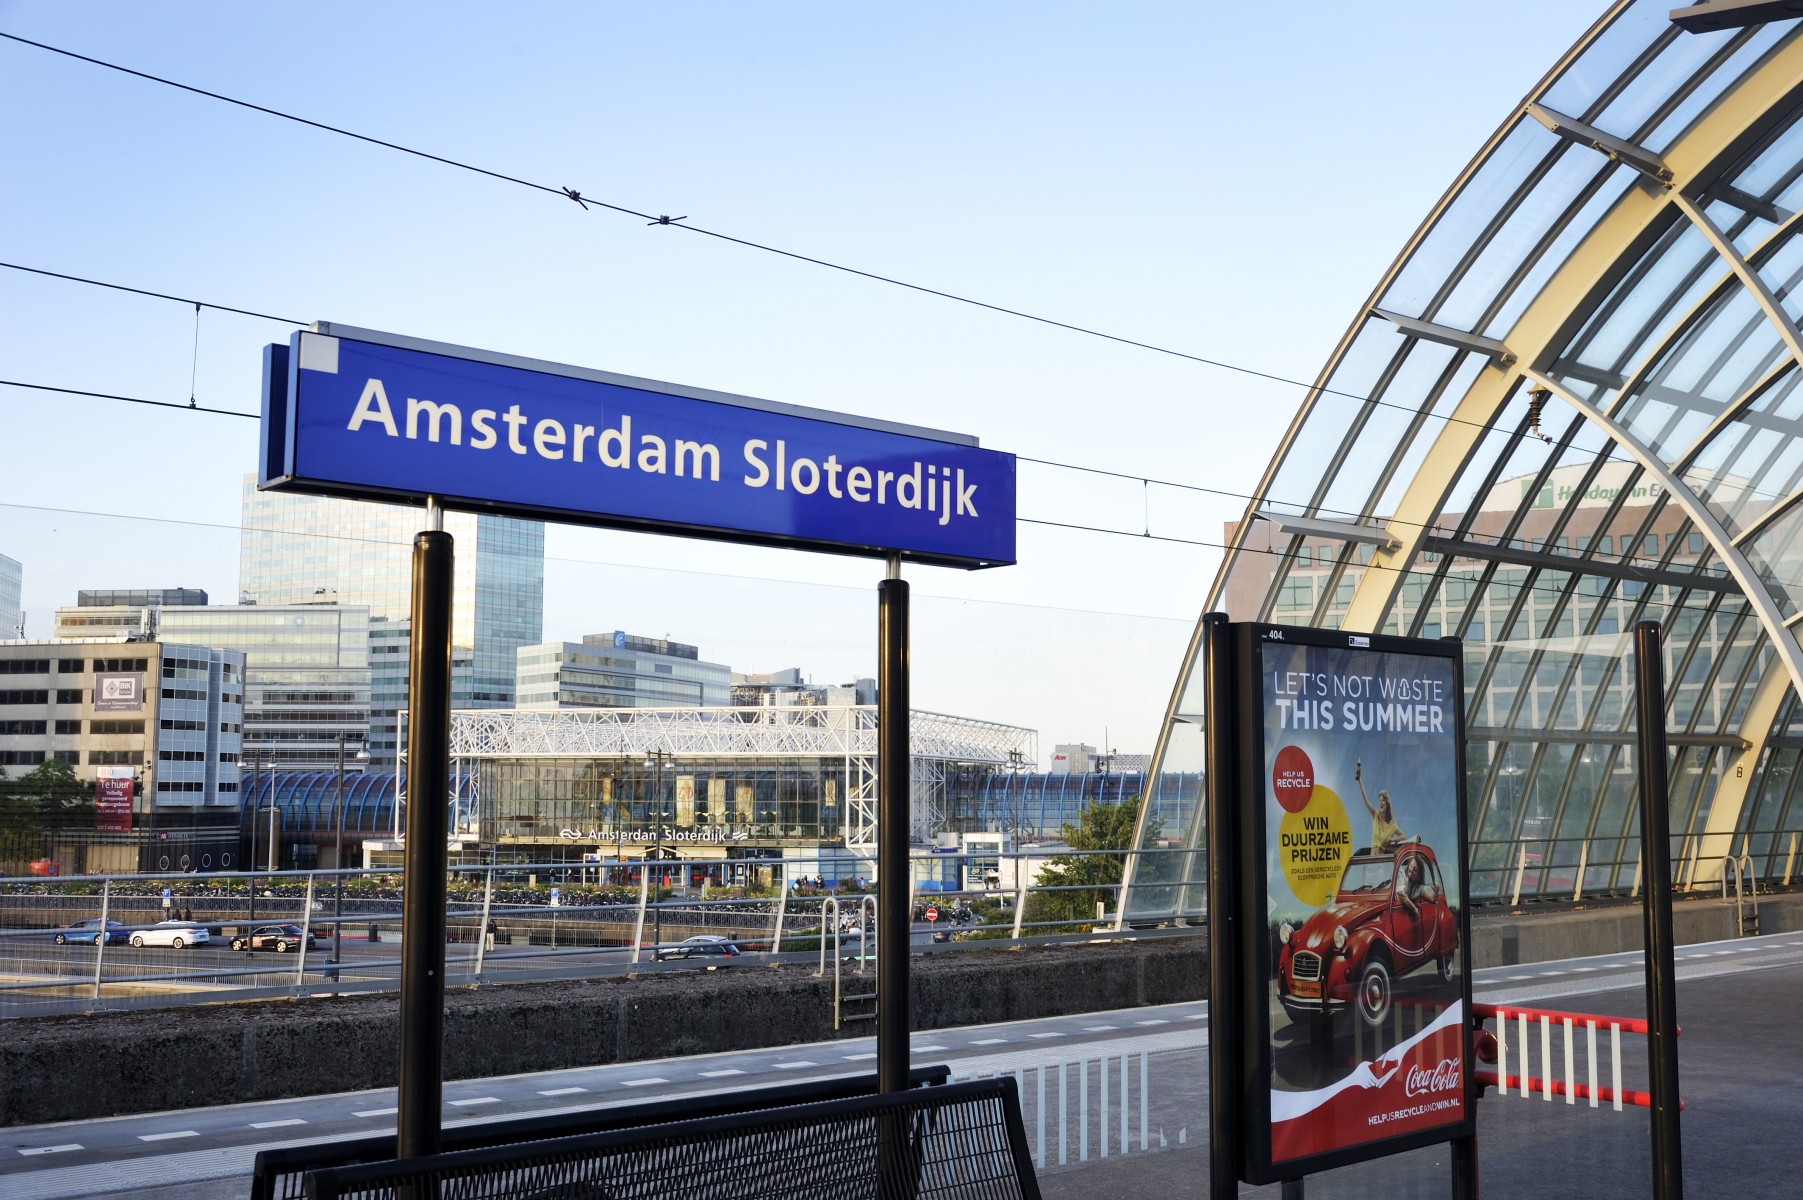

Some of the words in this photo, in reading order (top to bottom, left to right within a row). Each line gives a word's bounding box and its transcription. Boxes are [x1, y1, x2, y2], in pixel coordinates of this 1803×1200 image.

[347, 378, 721, 482] Amsterdam
[744, 439, 980, 526] Sloterdijk
[1274, 671, 1327, 697] LET'S
[1333, 674, 1373, 698] NOT
[1275, 698, 1334, 731] THIS
[1342, 701, 1444, 733] SUMMER
[111, 780, 130, 789] huur
[1277, 778, 1311, 788] RECYCLE
[1303, 816, 1329, 830] WIN
[665, 828, 726, 845] Sloterdijk
[1281, 831, 1350, 848] DUURZAME
[1291, 847, 1341, 863] PRIJZEN
[1405, 1057, 1462, 1098] Coca-Cola
[1368, 1098, 1461, 1126] HELPUSRECYCLEANDWIN.NL
